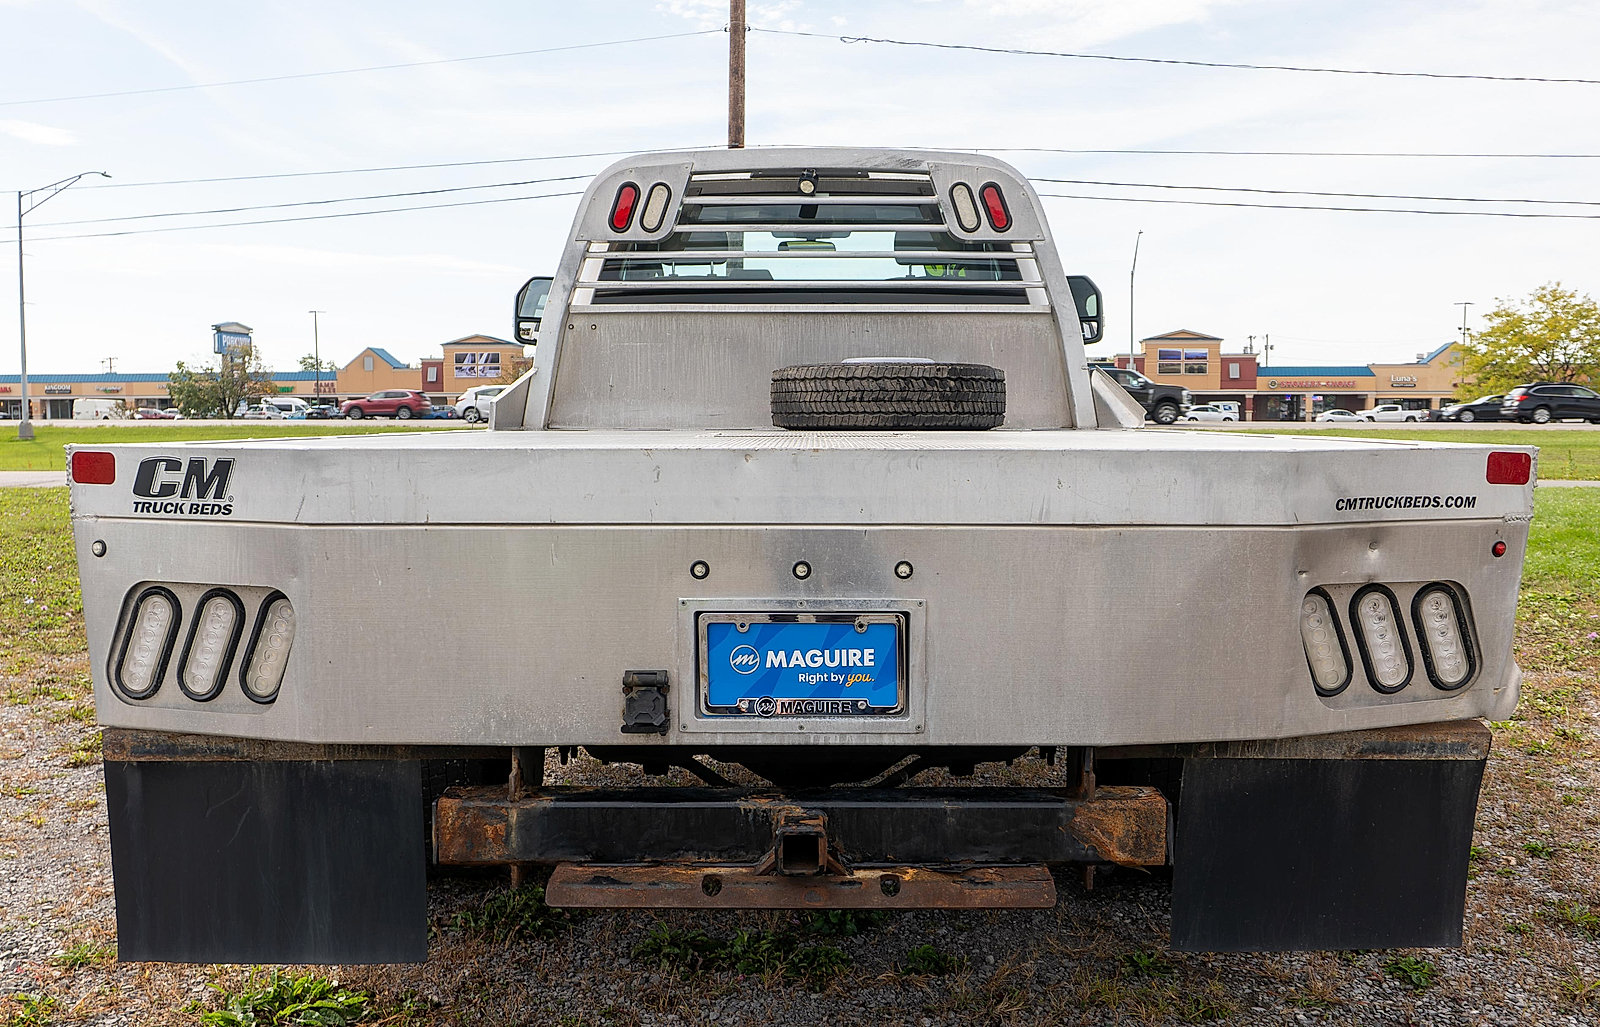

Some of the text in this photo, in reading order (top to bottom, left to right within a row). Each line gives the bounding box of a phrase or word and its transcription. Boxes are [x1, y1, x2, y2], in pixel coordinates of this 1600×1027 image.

[1280, 380, 1357, 388] SMOKERS CHOICE
[1391, 374, 1417, 382] Luna's
[132, 455, 236, 502] CM
[133, 501, 233, 515] TRUCK BEDS
[1335, 495, 1477, 511] CMTRUCKBEDS.COM
[765, 648, 875, 668] MAGUIRE
[798, 671, 875, 687] Right by you.
[780, 700, 852, 714] MAGUIRE
